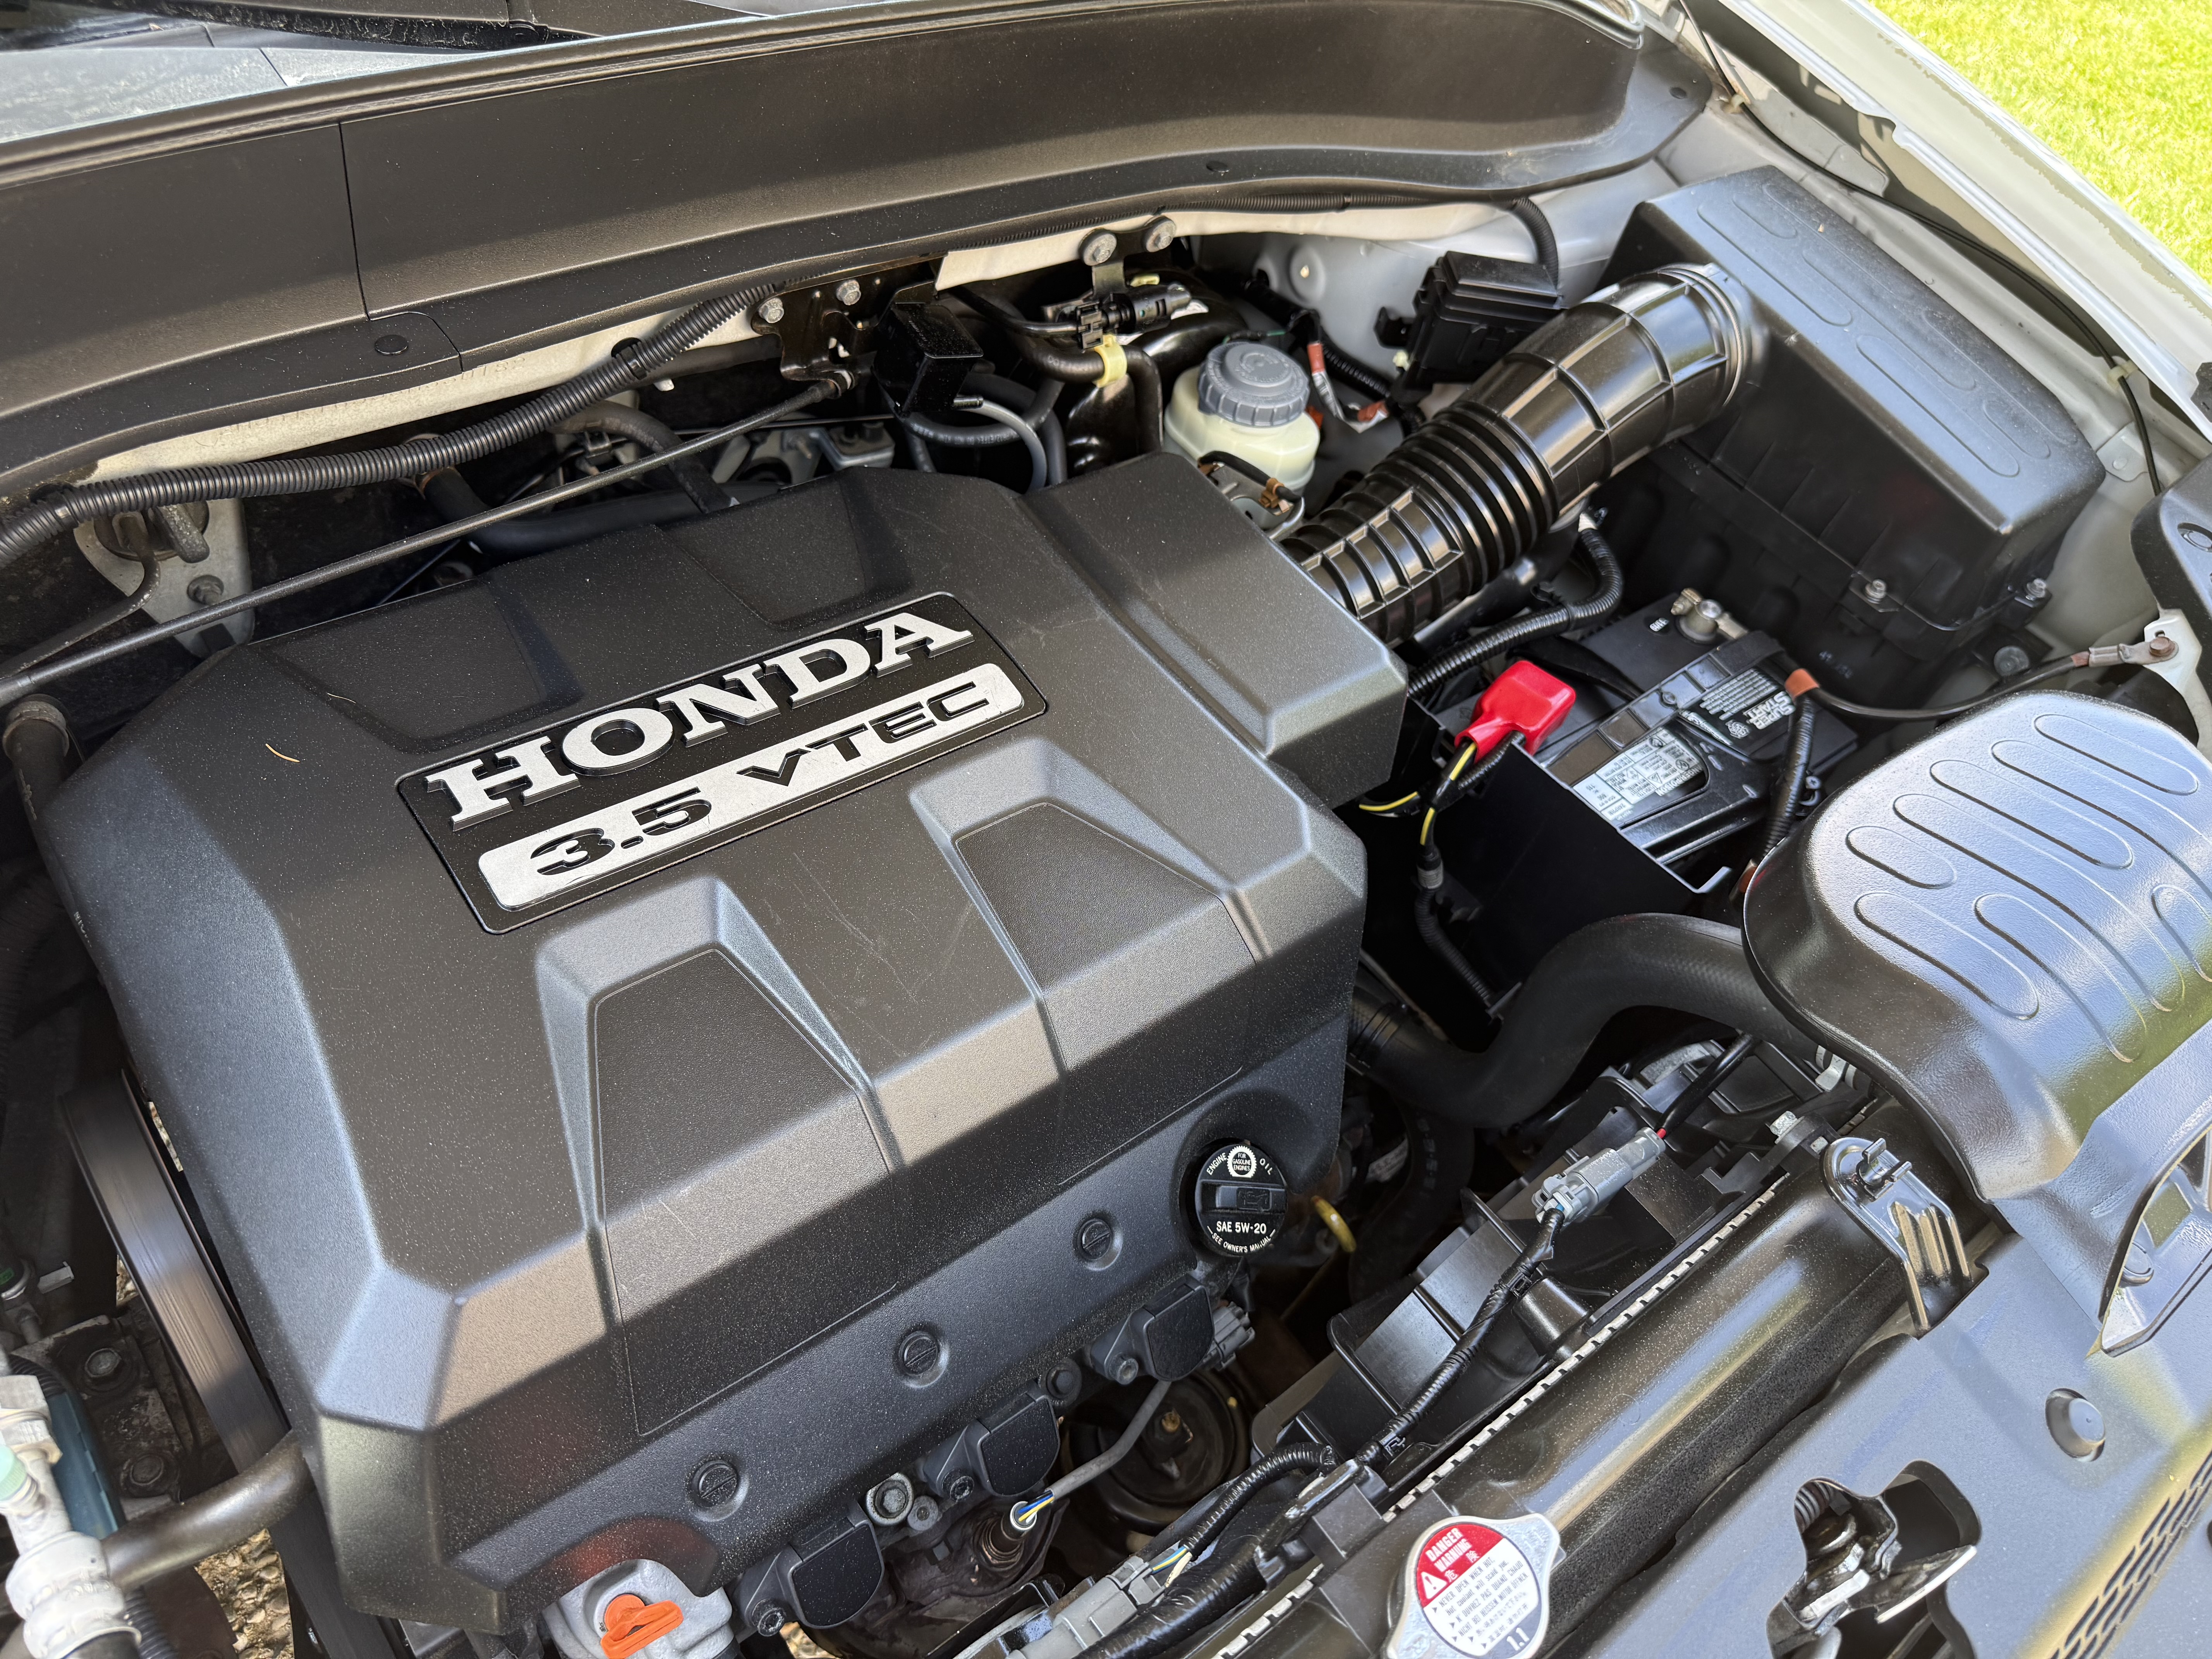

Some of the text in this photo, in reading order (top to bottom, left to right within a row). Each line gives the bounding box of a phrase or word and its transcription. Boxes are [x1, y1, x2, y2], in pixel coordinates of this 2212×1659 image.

[425, 611, 973, 831] HONDA
[1746, 690, 1790, 721] START
[1754, 701, 1796, 730] SUPER
[529, 681, 989, 876] 3.5 VTEC
[1206, 1152, 1274, 1175] ENGINE OIL
[1212, 1232, 1223, 1245] SEE
[1223, 1241, 1248, 1254] OWNER'S
[1216, 1221, 1232, 1233] SAE
[1425, 1526, 1463, 1562] DANGER
[1434, 1537, 1472, 1572] WARNUNG
[1438, 1590, 1455, 1607] NEVER
[1455, 1578, 1469, 1593] OPEN
[1468, 1565, 1483, 1580] WHEN
[1445, 1604, 1456, 1616] Hot
[1474, 1579, 1485, 1590] will
[1480, 1589, 1492, 1601] PAS
[1491, 1574, 1508, 1590] QUAND
[1506, 1560, 1523, 1576] CHAUD
[1457, 1621, 1472, 1637] NICHT
[1497, 1585, 1513, 1601] MOTOR
[1506, 1627, 1530, 1651] 1.1
